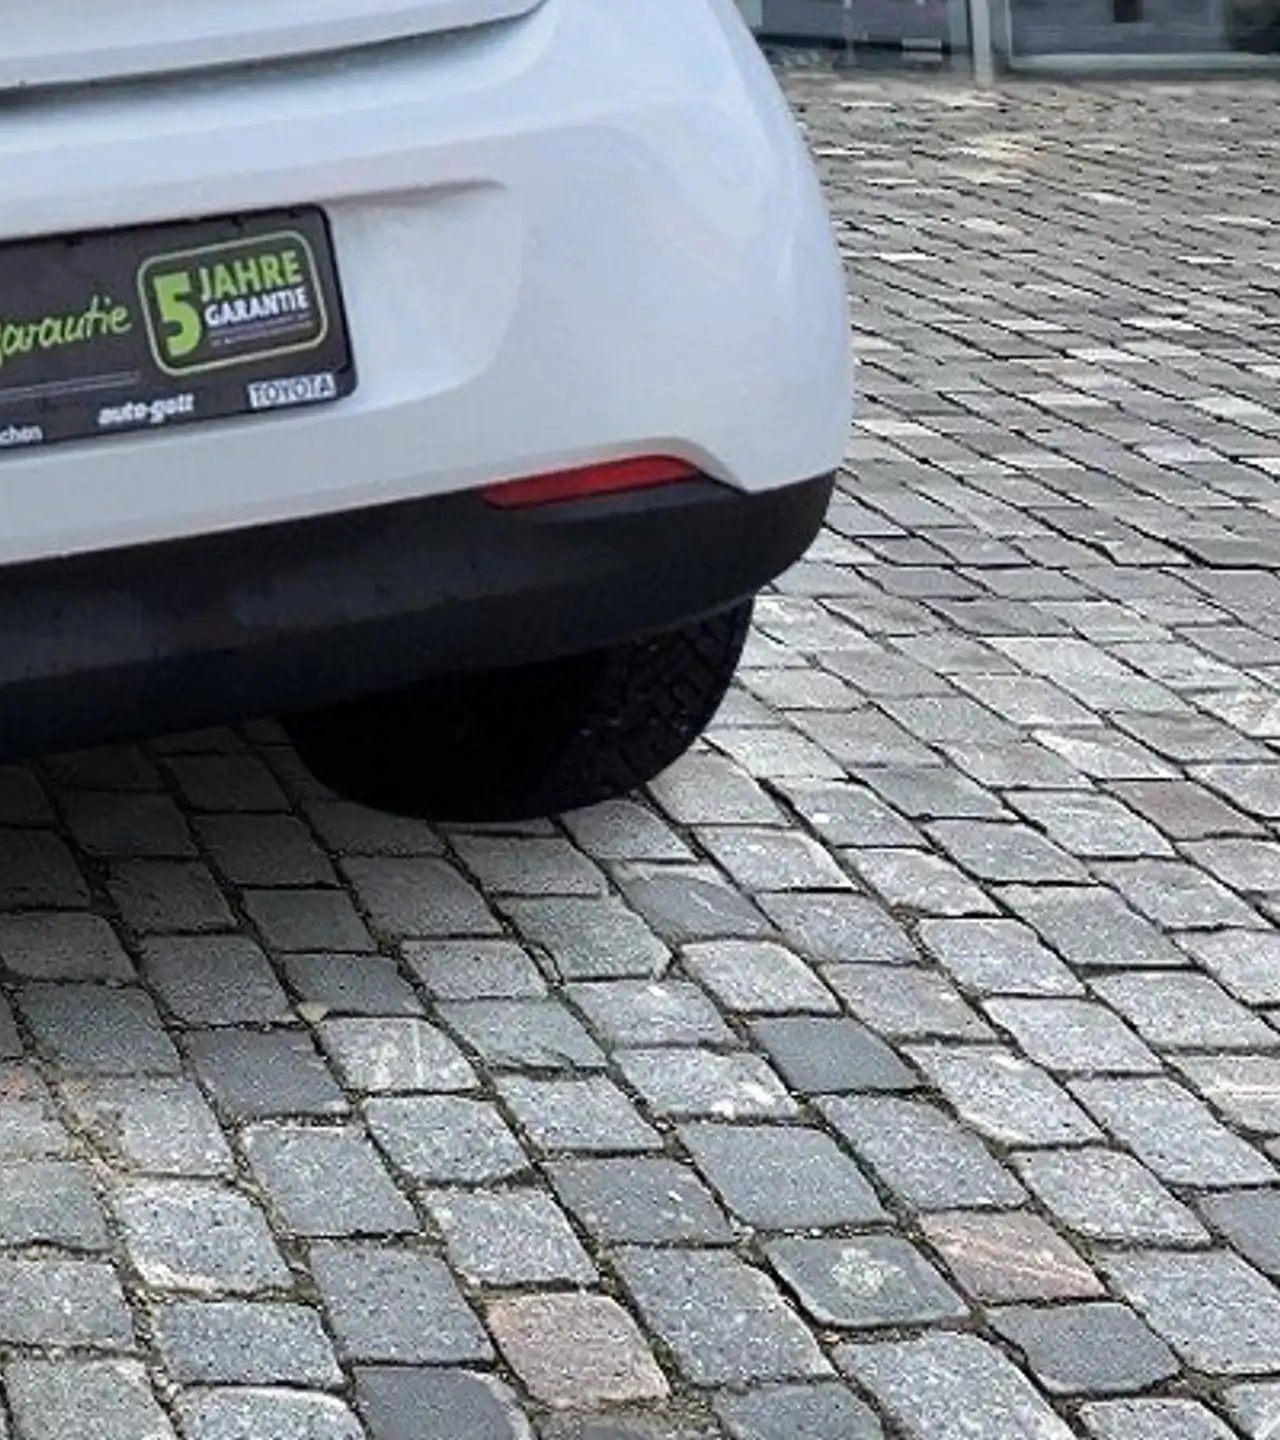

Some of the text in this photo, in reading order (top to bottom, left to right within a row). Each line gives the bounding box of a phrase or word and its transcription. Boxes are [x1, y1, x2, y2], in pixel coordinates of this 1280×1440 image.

[153, 271, 202, 358] 5
[198, 250, 303, 303] JAHRE
[203, 286, 310, 328] GARANTIE
[248, 375, 336, 407] TOYOTA
